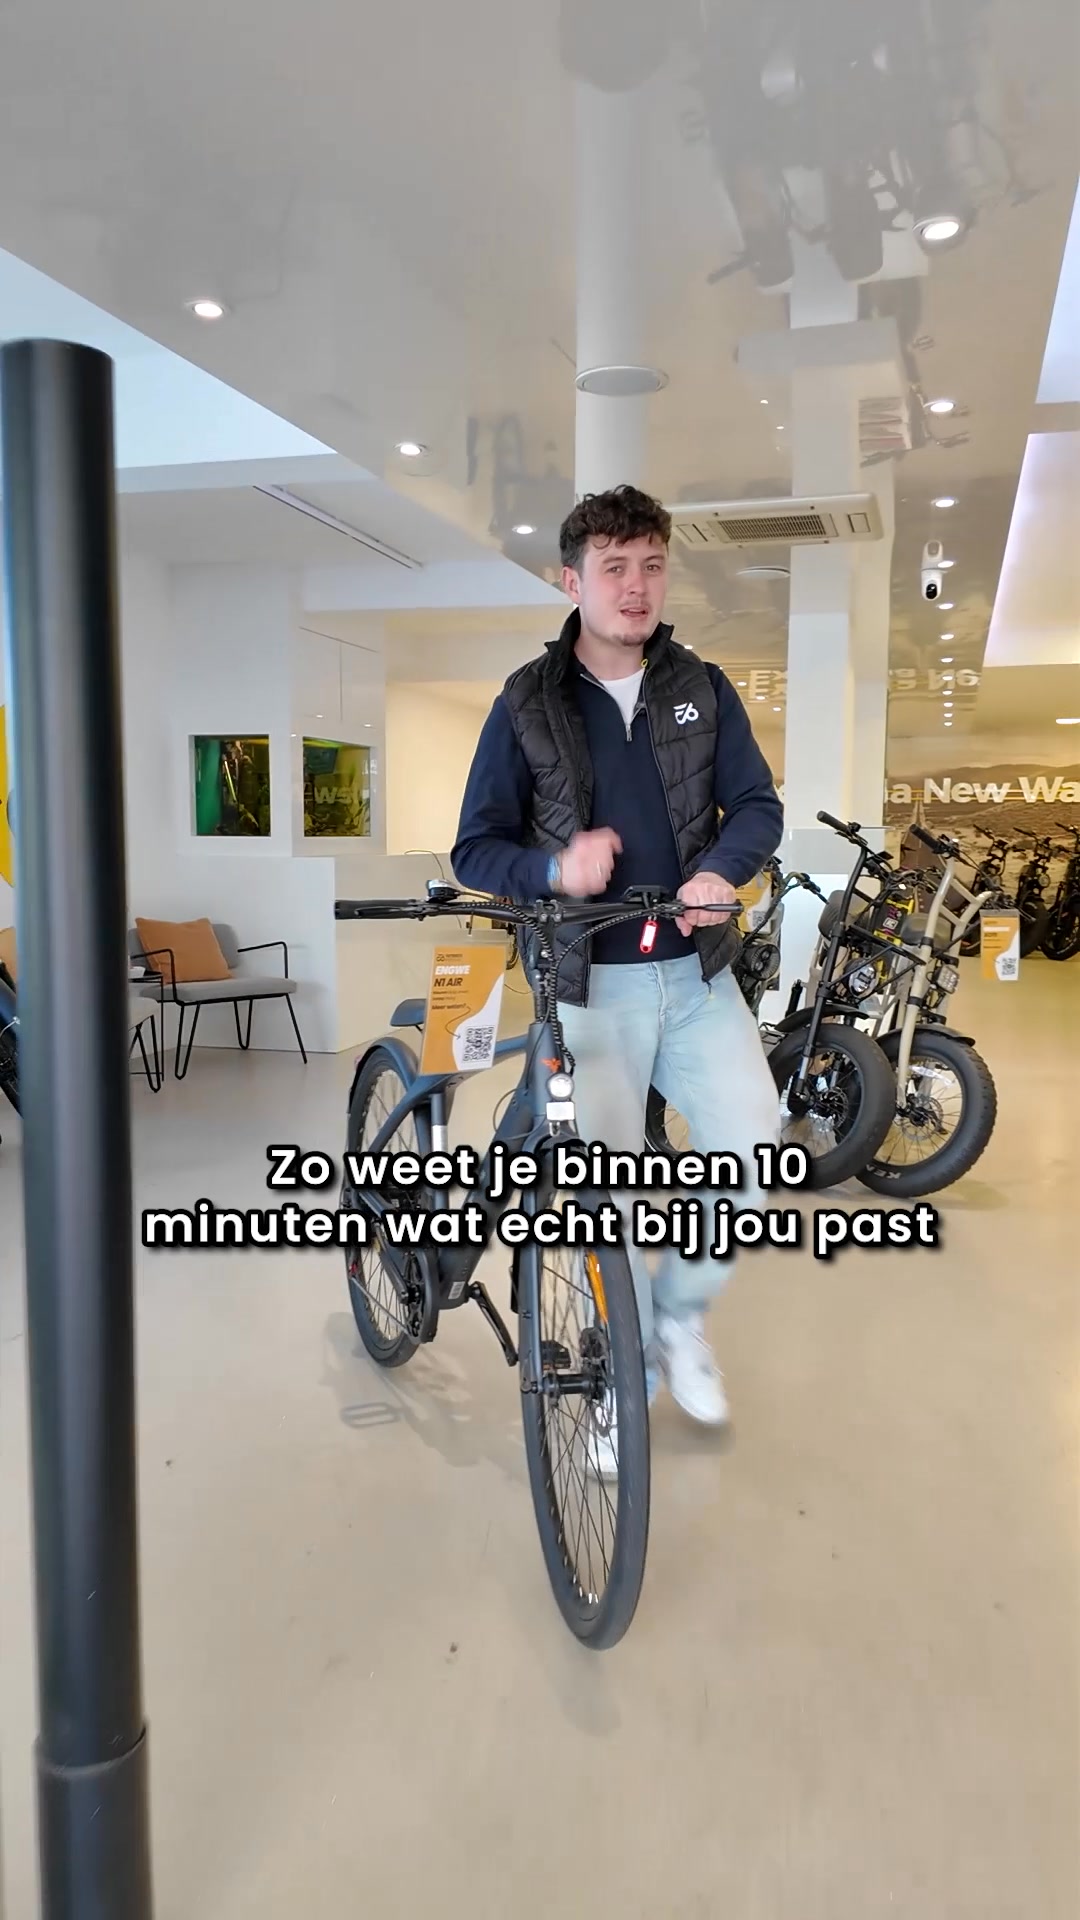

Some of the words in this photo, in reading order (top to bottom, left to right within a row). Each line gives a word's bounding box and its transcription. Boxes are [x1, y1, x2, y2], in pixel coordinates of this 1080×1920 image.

[923, 777, 1011, 804] New
[435, 965, 470, 975] ENGWE
[434, 977, 446, 987] N1
[446, 977, 463, 987] AIR
